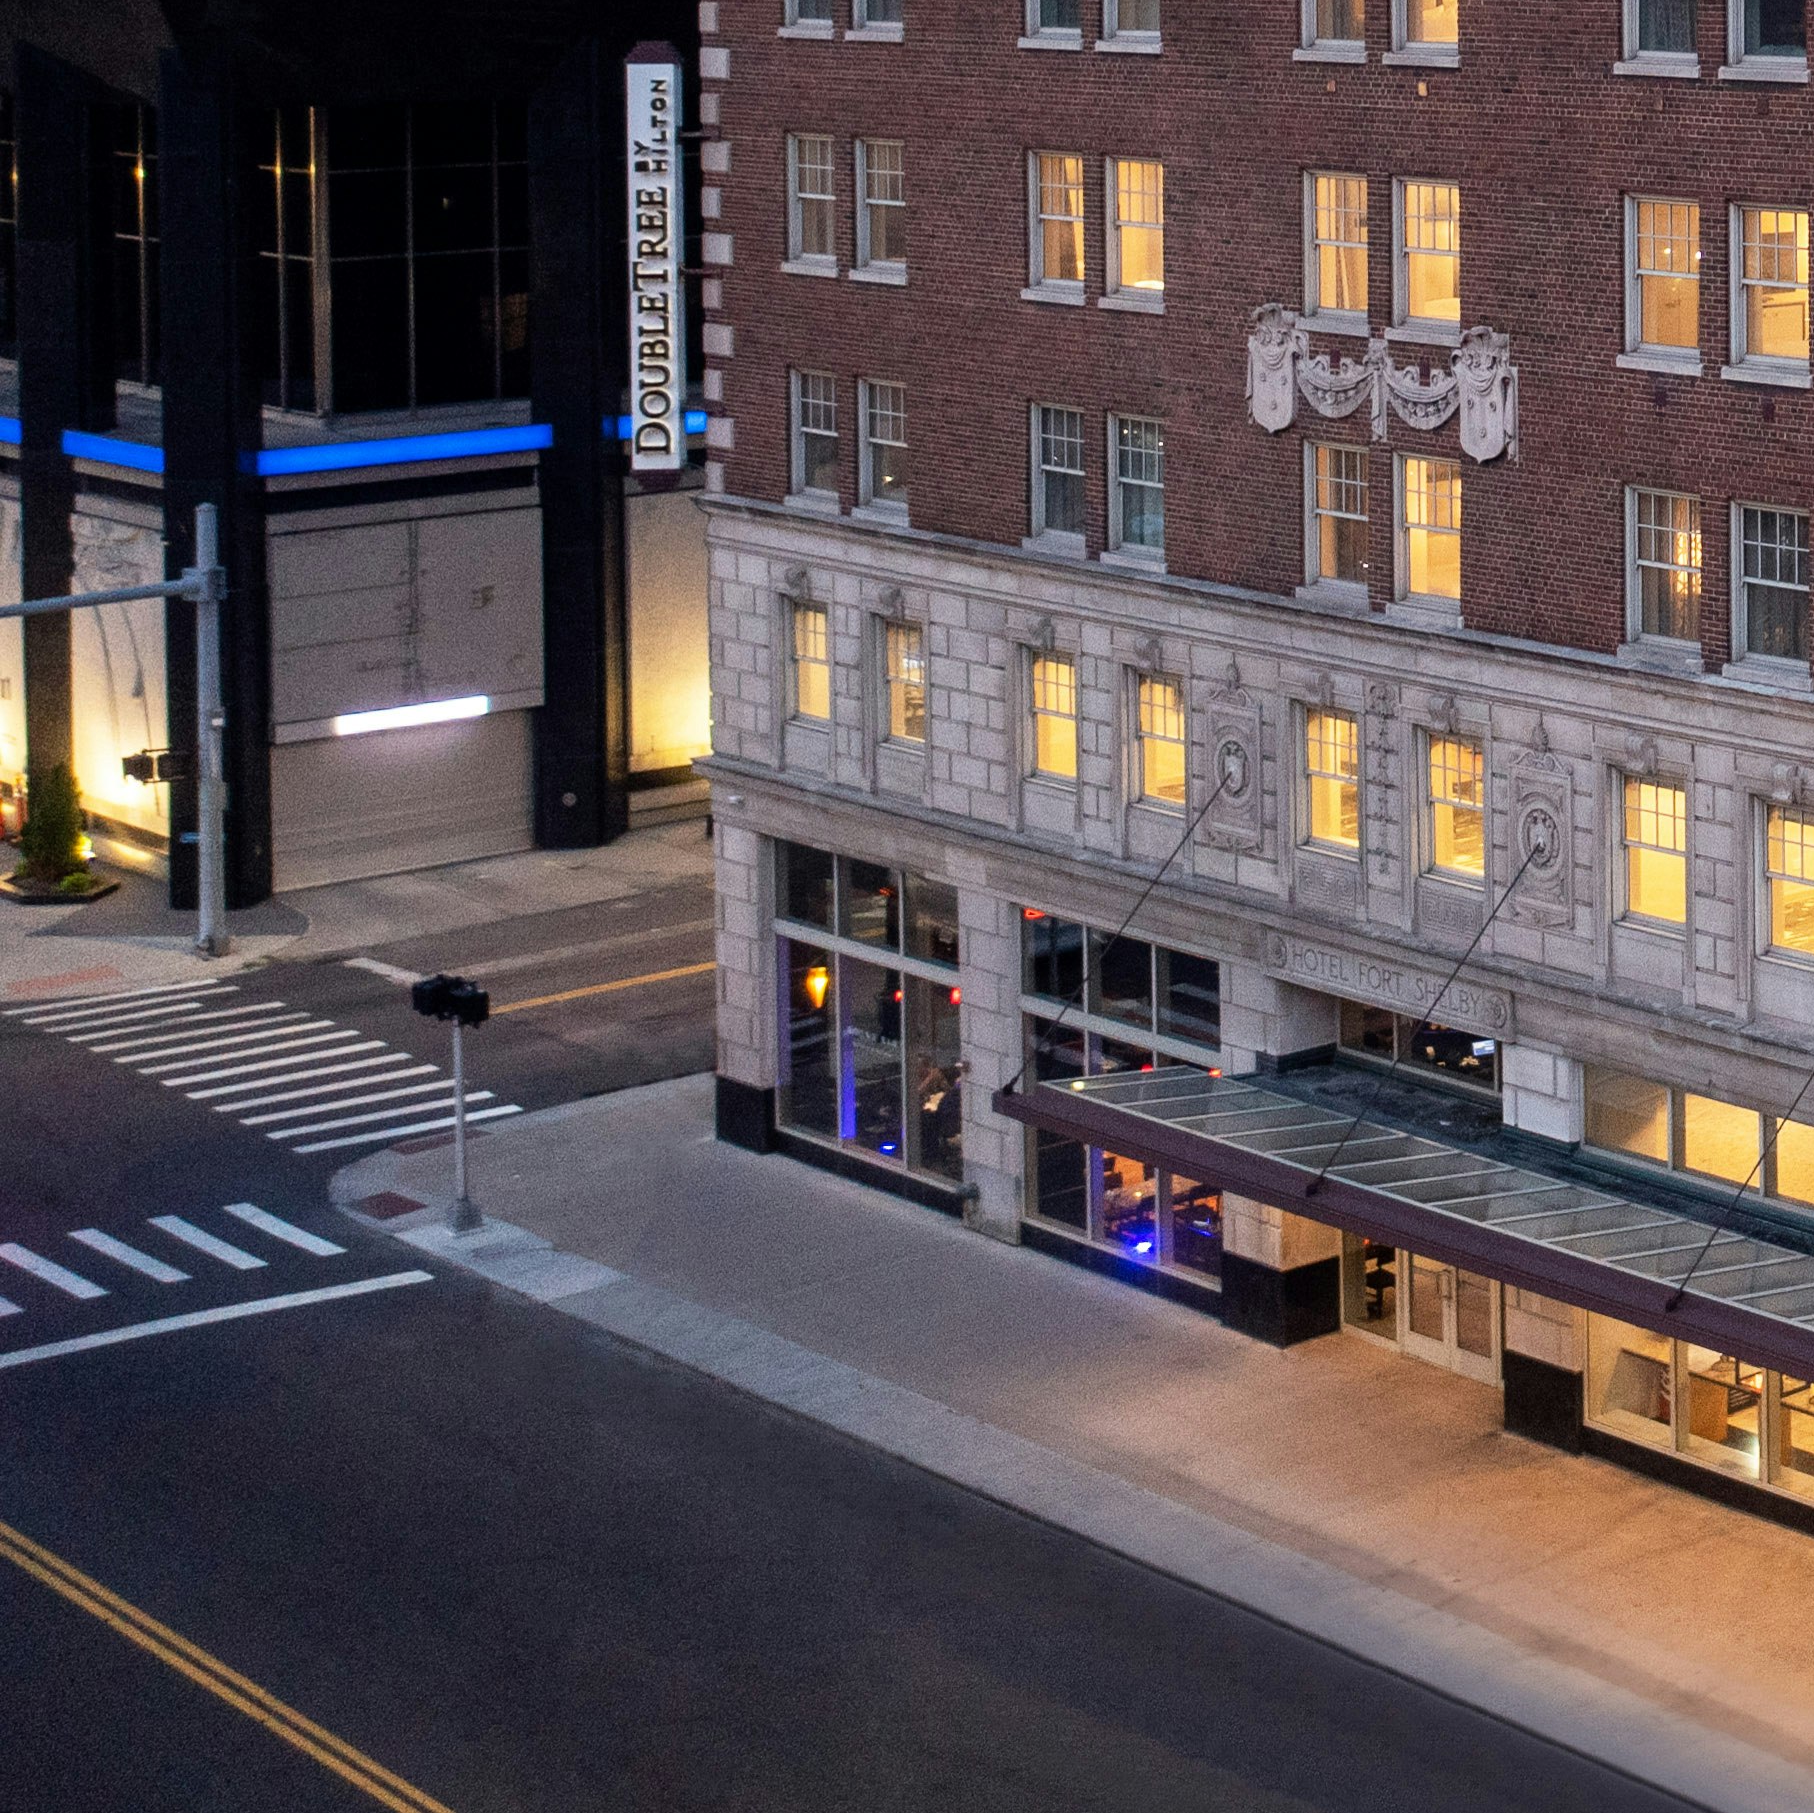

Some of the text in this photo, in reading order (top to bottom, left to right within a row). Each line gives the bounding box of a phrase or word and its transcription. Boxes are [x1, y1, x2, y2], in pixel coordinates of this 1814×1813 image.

[633, 140, 650, 173] BY
[650, 79, 668, 173] HILTON
[1292, 945, 1482, 1017] HOTEL FORT SHELBY
